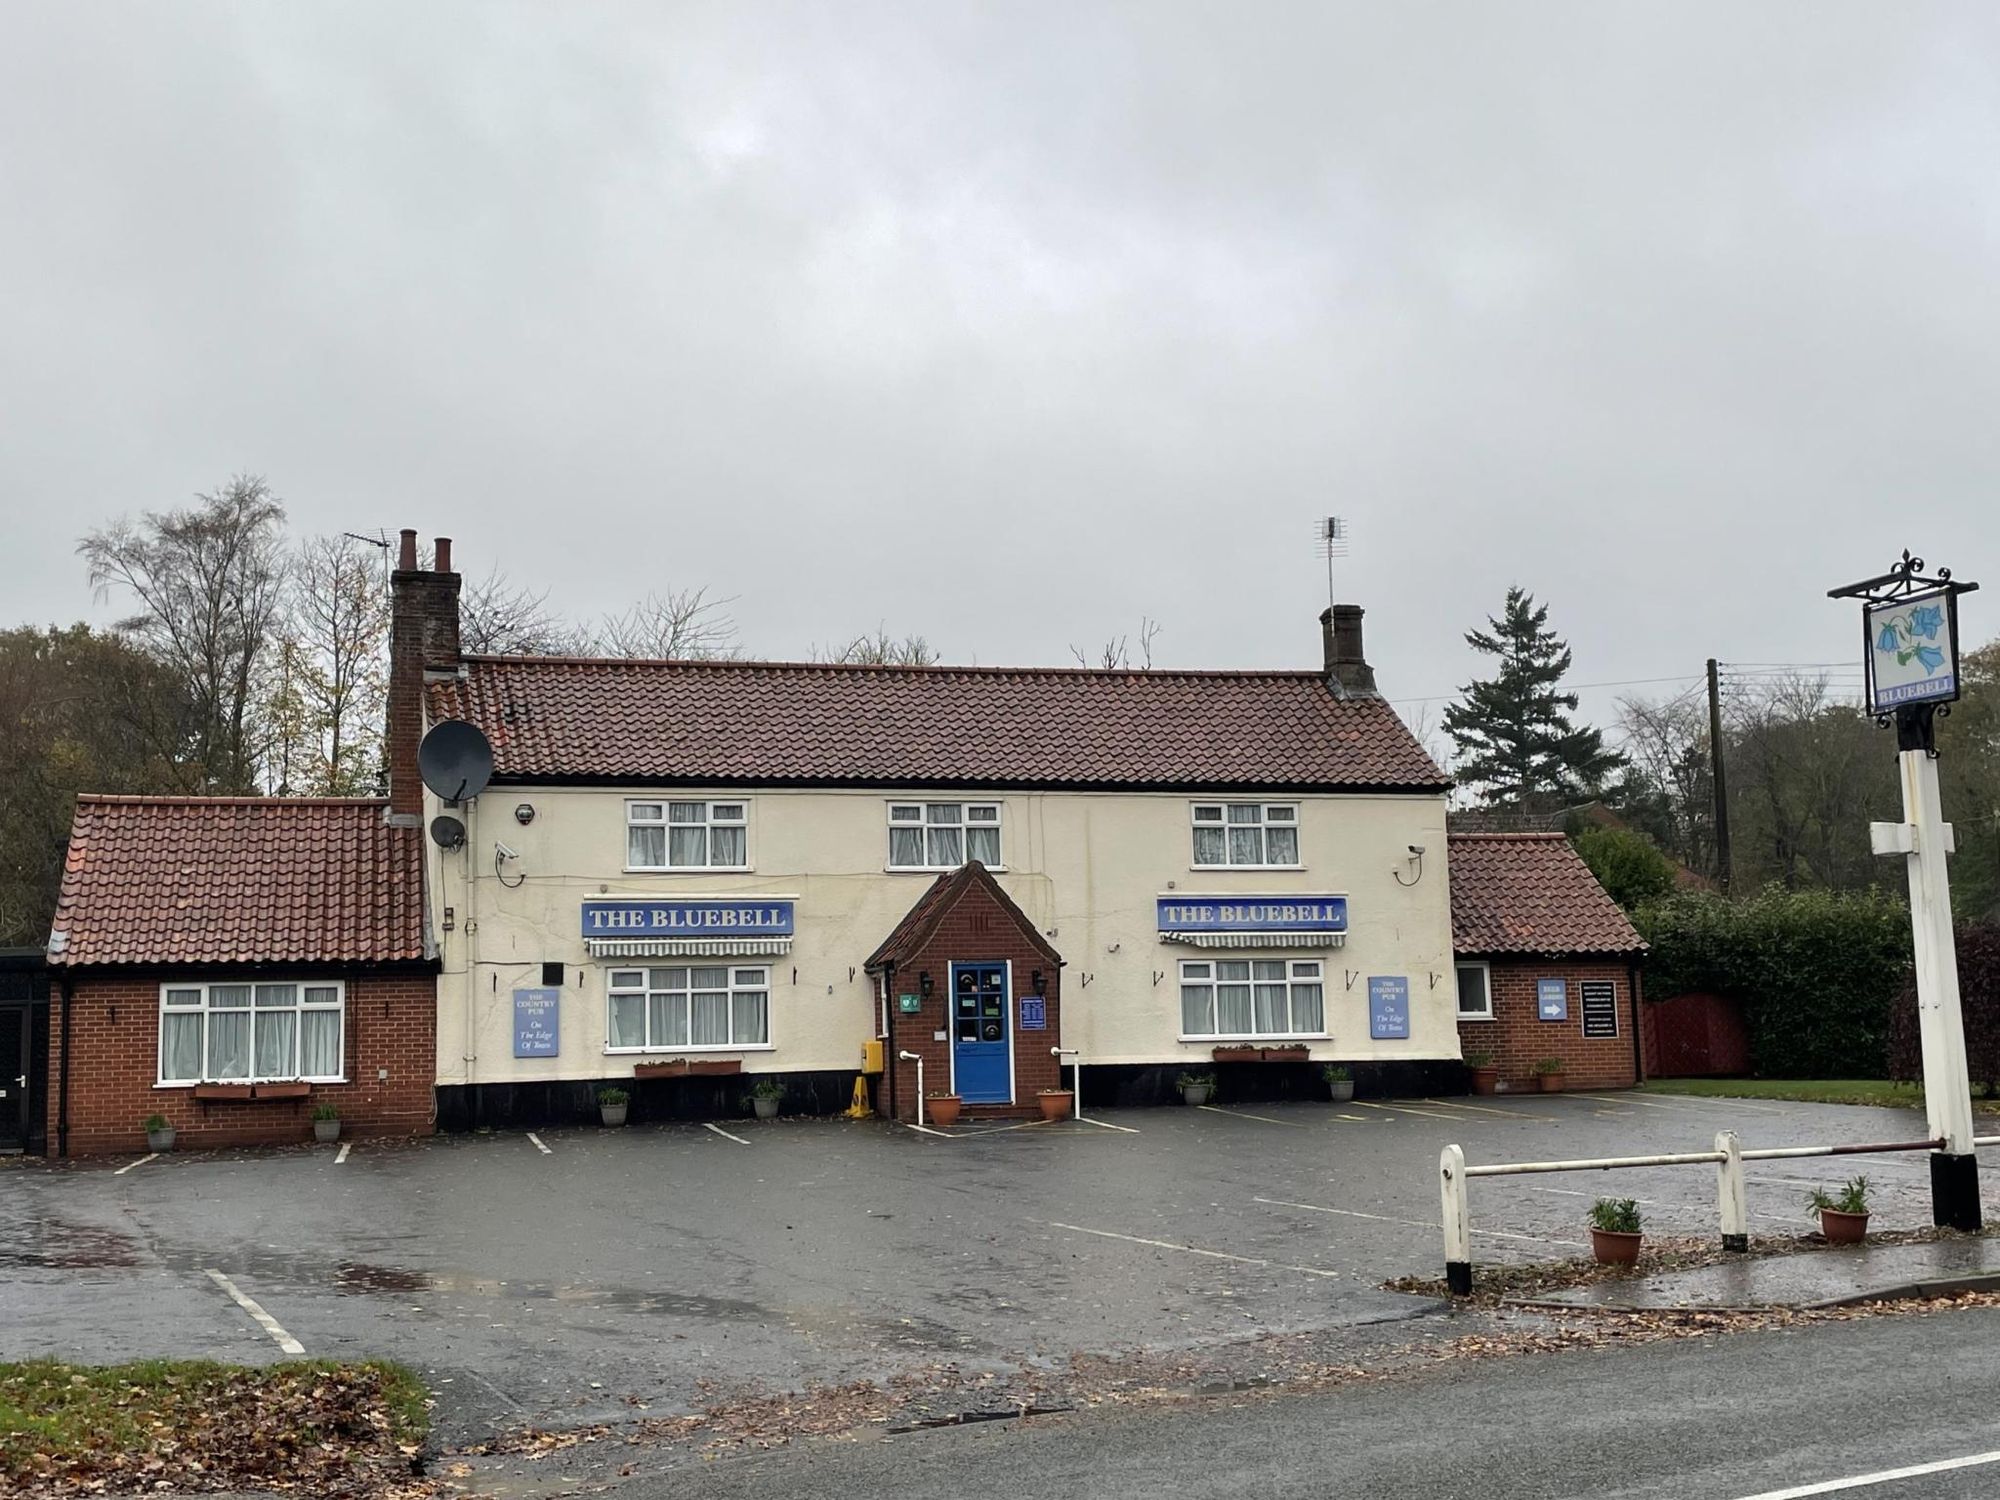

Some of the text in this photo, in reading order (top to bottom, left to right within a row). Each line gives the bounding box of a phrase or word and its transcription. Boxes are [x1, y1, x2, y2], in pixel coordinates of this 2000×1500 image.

[1879, 679, 1951, 703] BLUEBELL
[589, 909, 786, 928] THE BLUEBELL
[1164, 905, 1340, 923] THE BLUEBELL
[516, 1000, 555, 1008] COUNTRY
[530, 1020, 542, 1029] On
[520, 1031, 553, 1041] The Edge
[521, 1041, 532, 1052] Of
